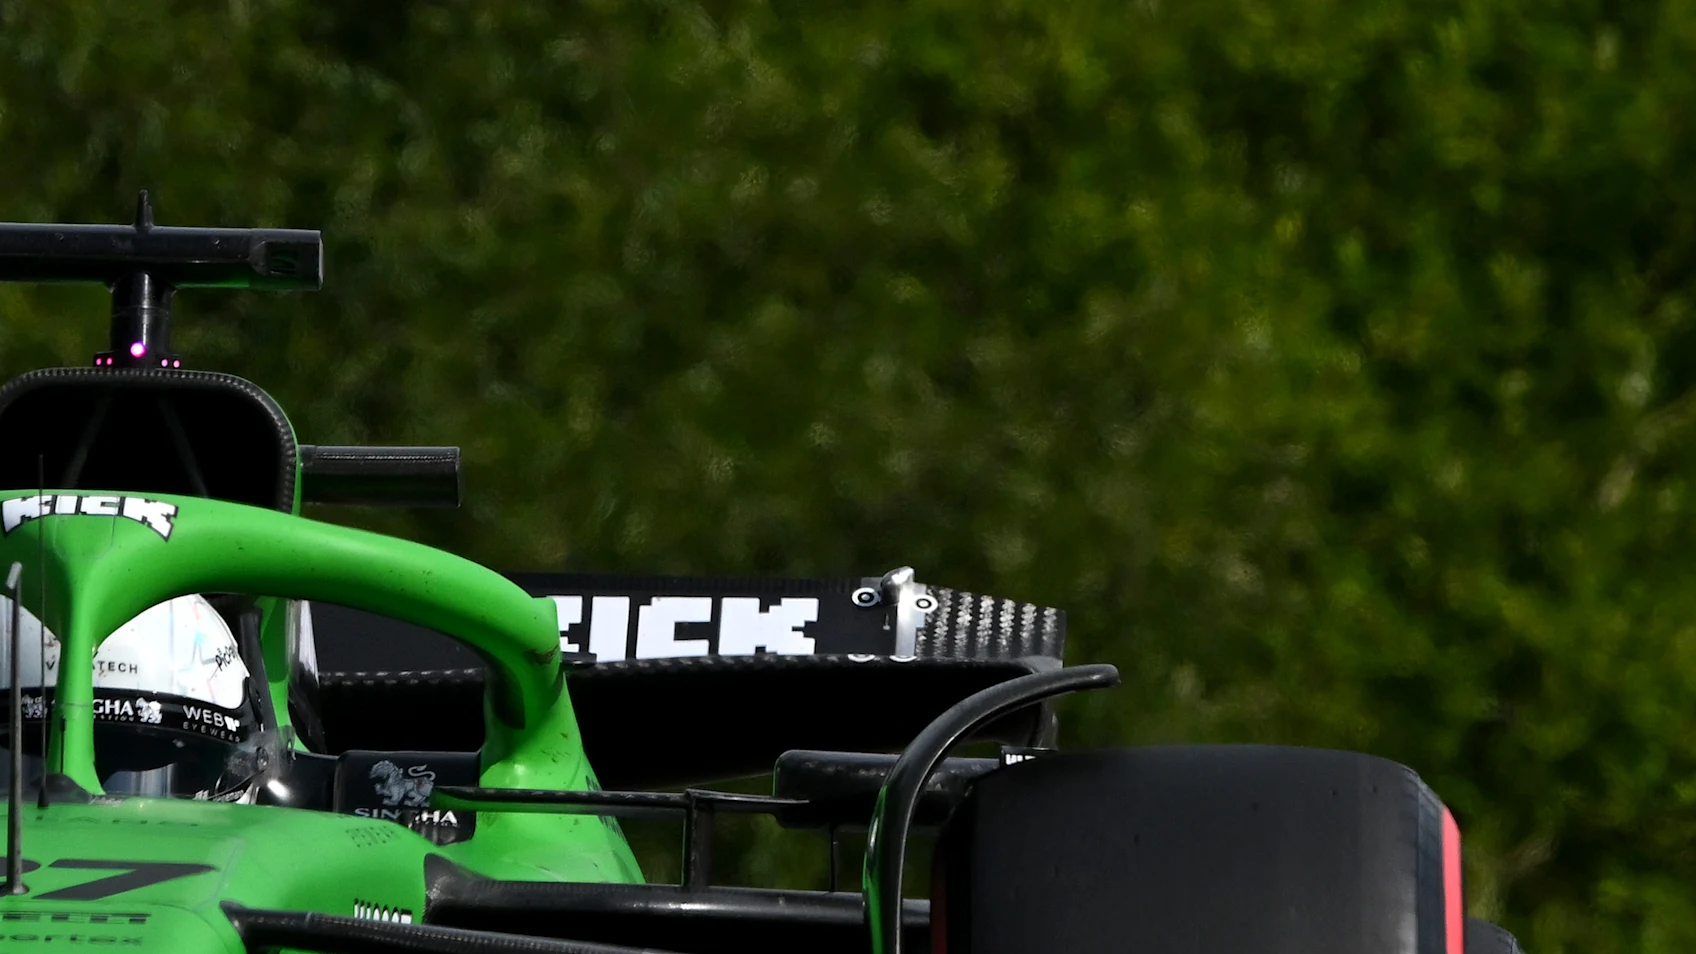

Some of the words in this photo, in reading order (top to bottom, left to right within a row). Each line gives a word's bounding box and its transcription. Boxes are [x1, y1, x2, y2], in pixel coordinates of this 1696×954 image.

[0, 493, 179, 543] KICK
[556, 596, 819, 662] ICK
[182, 705, 225, 728] WEB
[182, 721, 241, 744] EYEWEAR
[354, 807, 458, 824] SINHA
